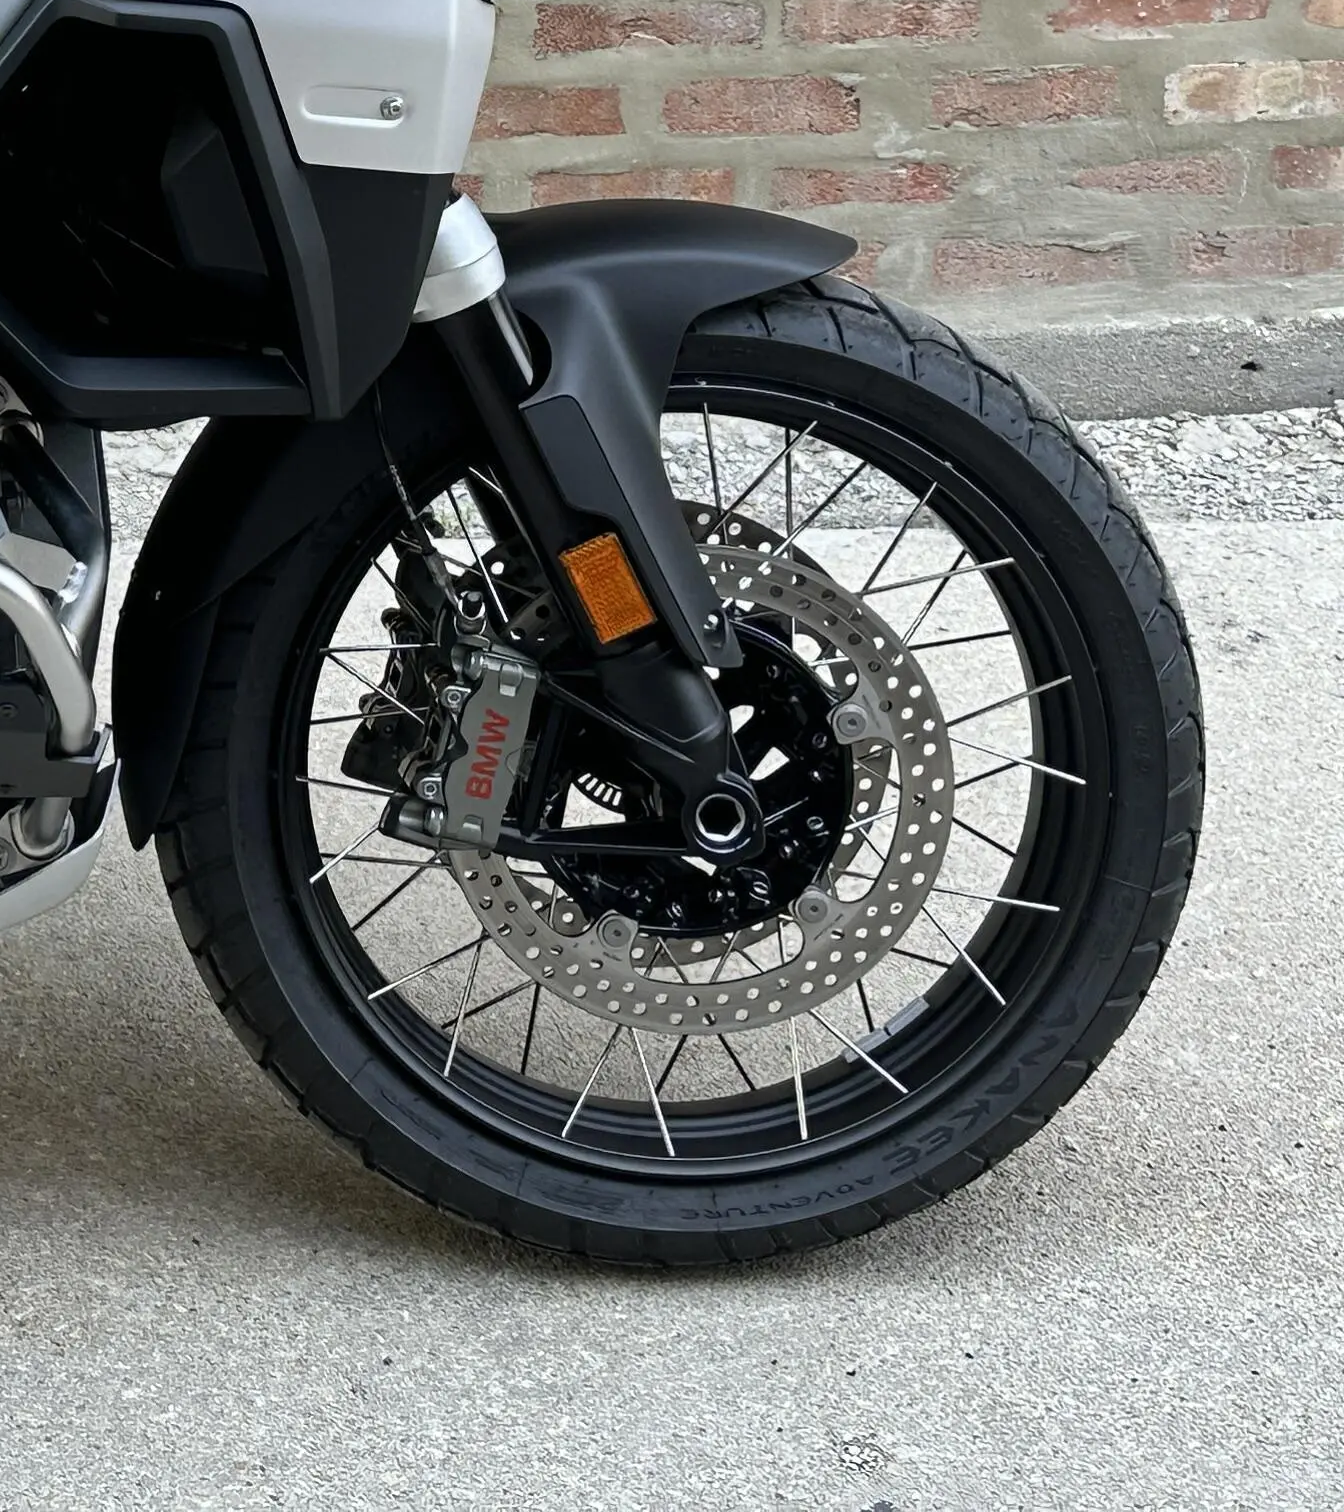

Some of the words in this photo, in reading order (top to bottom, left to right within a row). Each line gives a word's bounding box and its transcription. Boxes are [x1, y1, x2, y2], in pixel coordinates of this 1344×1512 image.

[465, 708, 510, 799] BMW
[881, 996, 1079, 1176] ANAKEE
[680, 1173, 875, 1221] ADVENTURE
